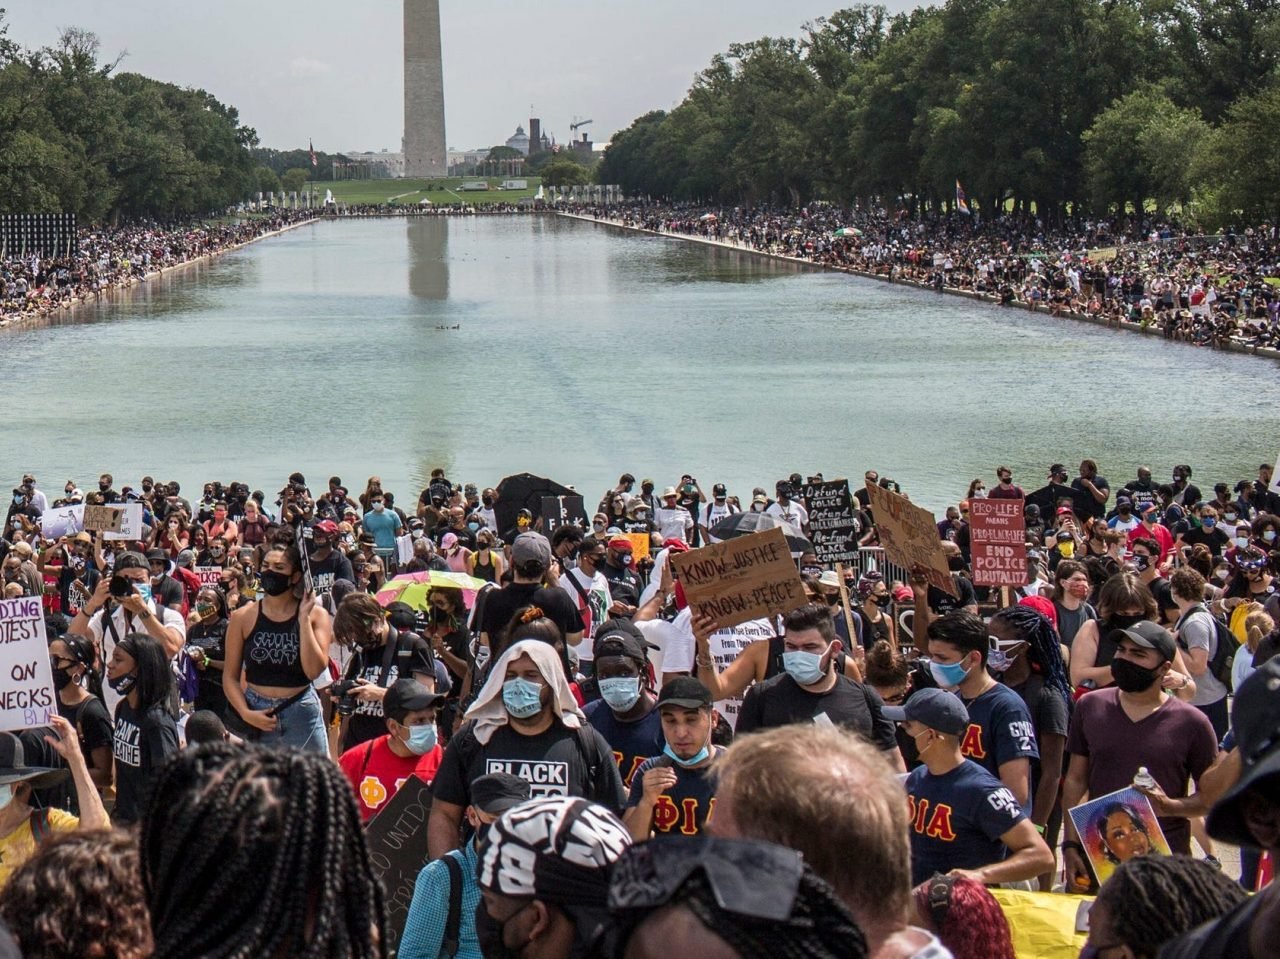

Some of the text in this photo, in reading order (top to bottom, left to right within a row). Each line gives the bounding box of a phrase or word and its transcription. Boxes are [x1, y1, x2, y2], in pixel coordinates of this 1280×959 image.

[806, 485, 846, 497] Defund
[811, 498, 842, 508] POLICE
[972, 502, 1020, 515] PRO-LIFE
[810, 507, 850, 519] Defund
[985, 517, 1009, 525] MEANS
[972, 528, 1025, 542] PRO-BLACK-LIFE
[815, 544, 847, 554] BLACK
[985, 545, 1014, 557] END
[681, 557, 726, 583] KNOW
[733, 542, 781, 569] JUSTICE
[976, 556, 1025, 570] POLICE
[974, 570, 1028, 584] BRUTALITY
[698, 581, 796, 620] KNOW PEACE
[745, 626, 760, 637] Every
[721, 639, 736, 649] From
[11, 661, 37, 681] ON
